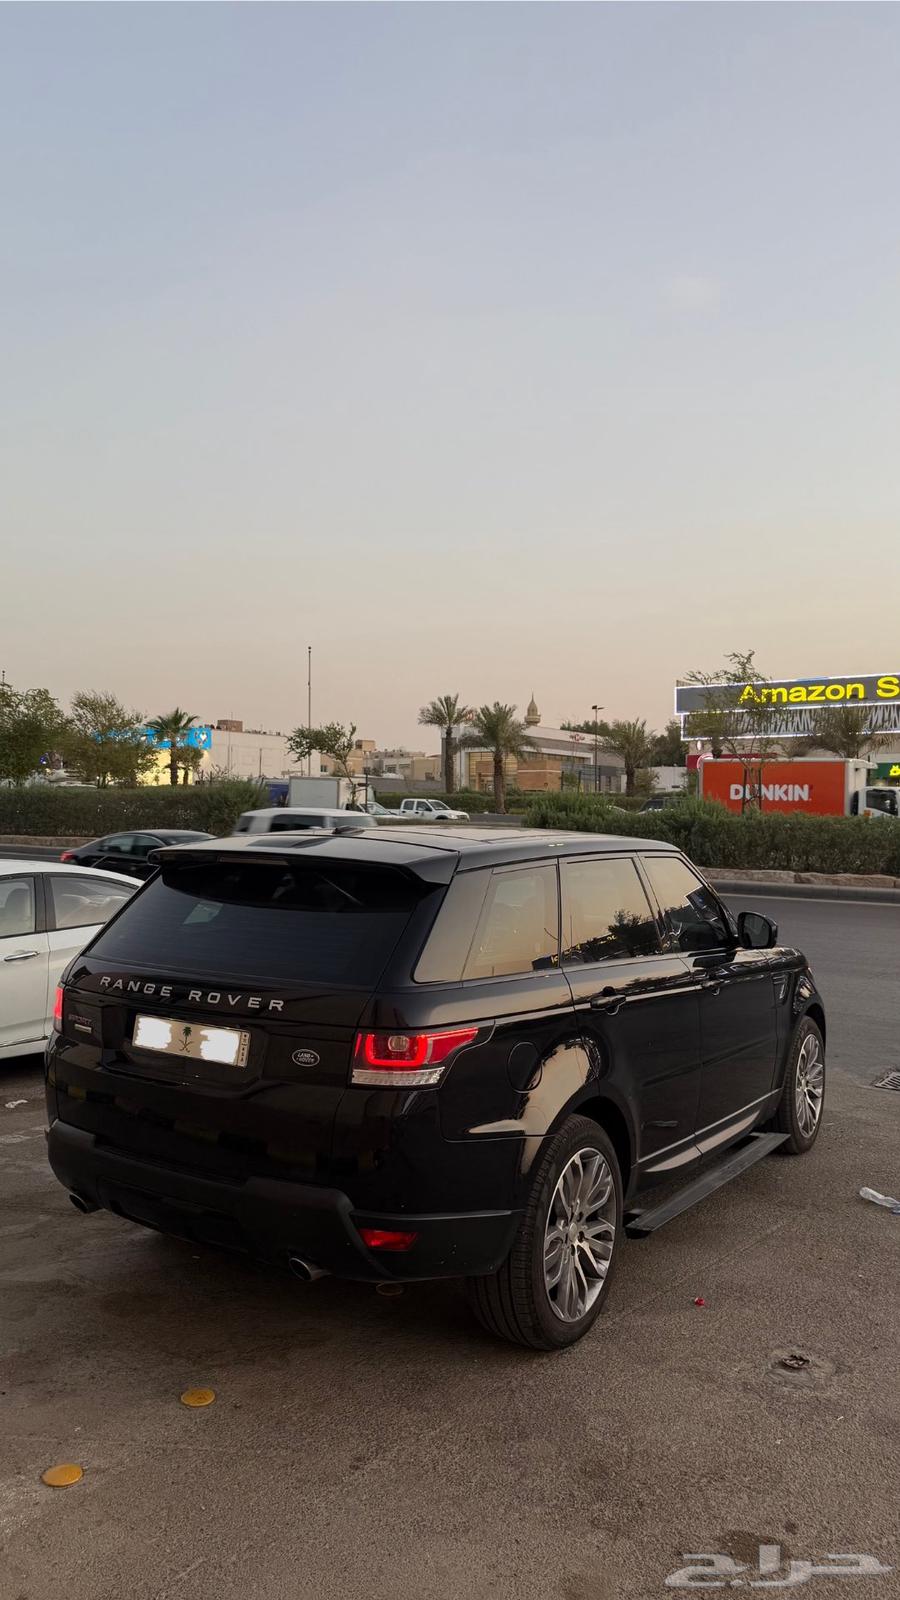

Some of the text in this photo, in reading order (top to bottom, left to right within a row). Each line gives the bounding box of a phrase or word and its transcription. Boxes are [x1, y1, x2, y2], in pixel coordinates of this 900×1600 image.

[738, 676, 899, 705] Amazon S
[99, 976, 284, 1012] RANGE ROVER
